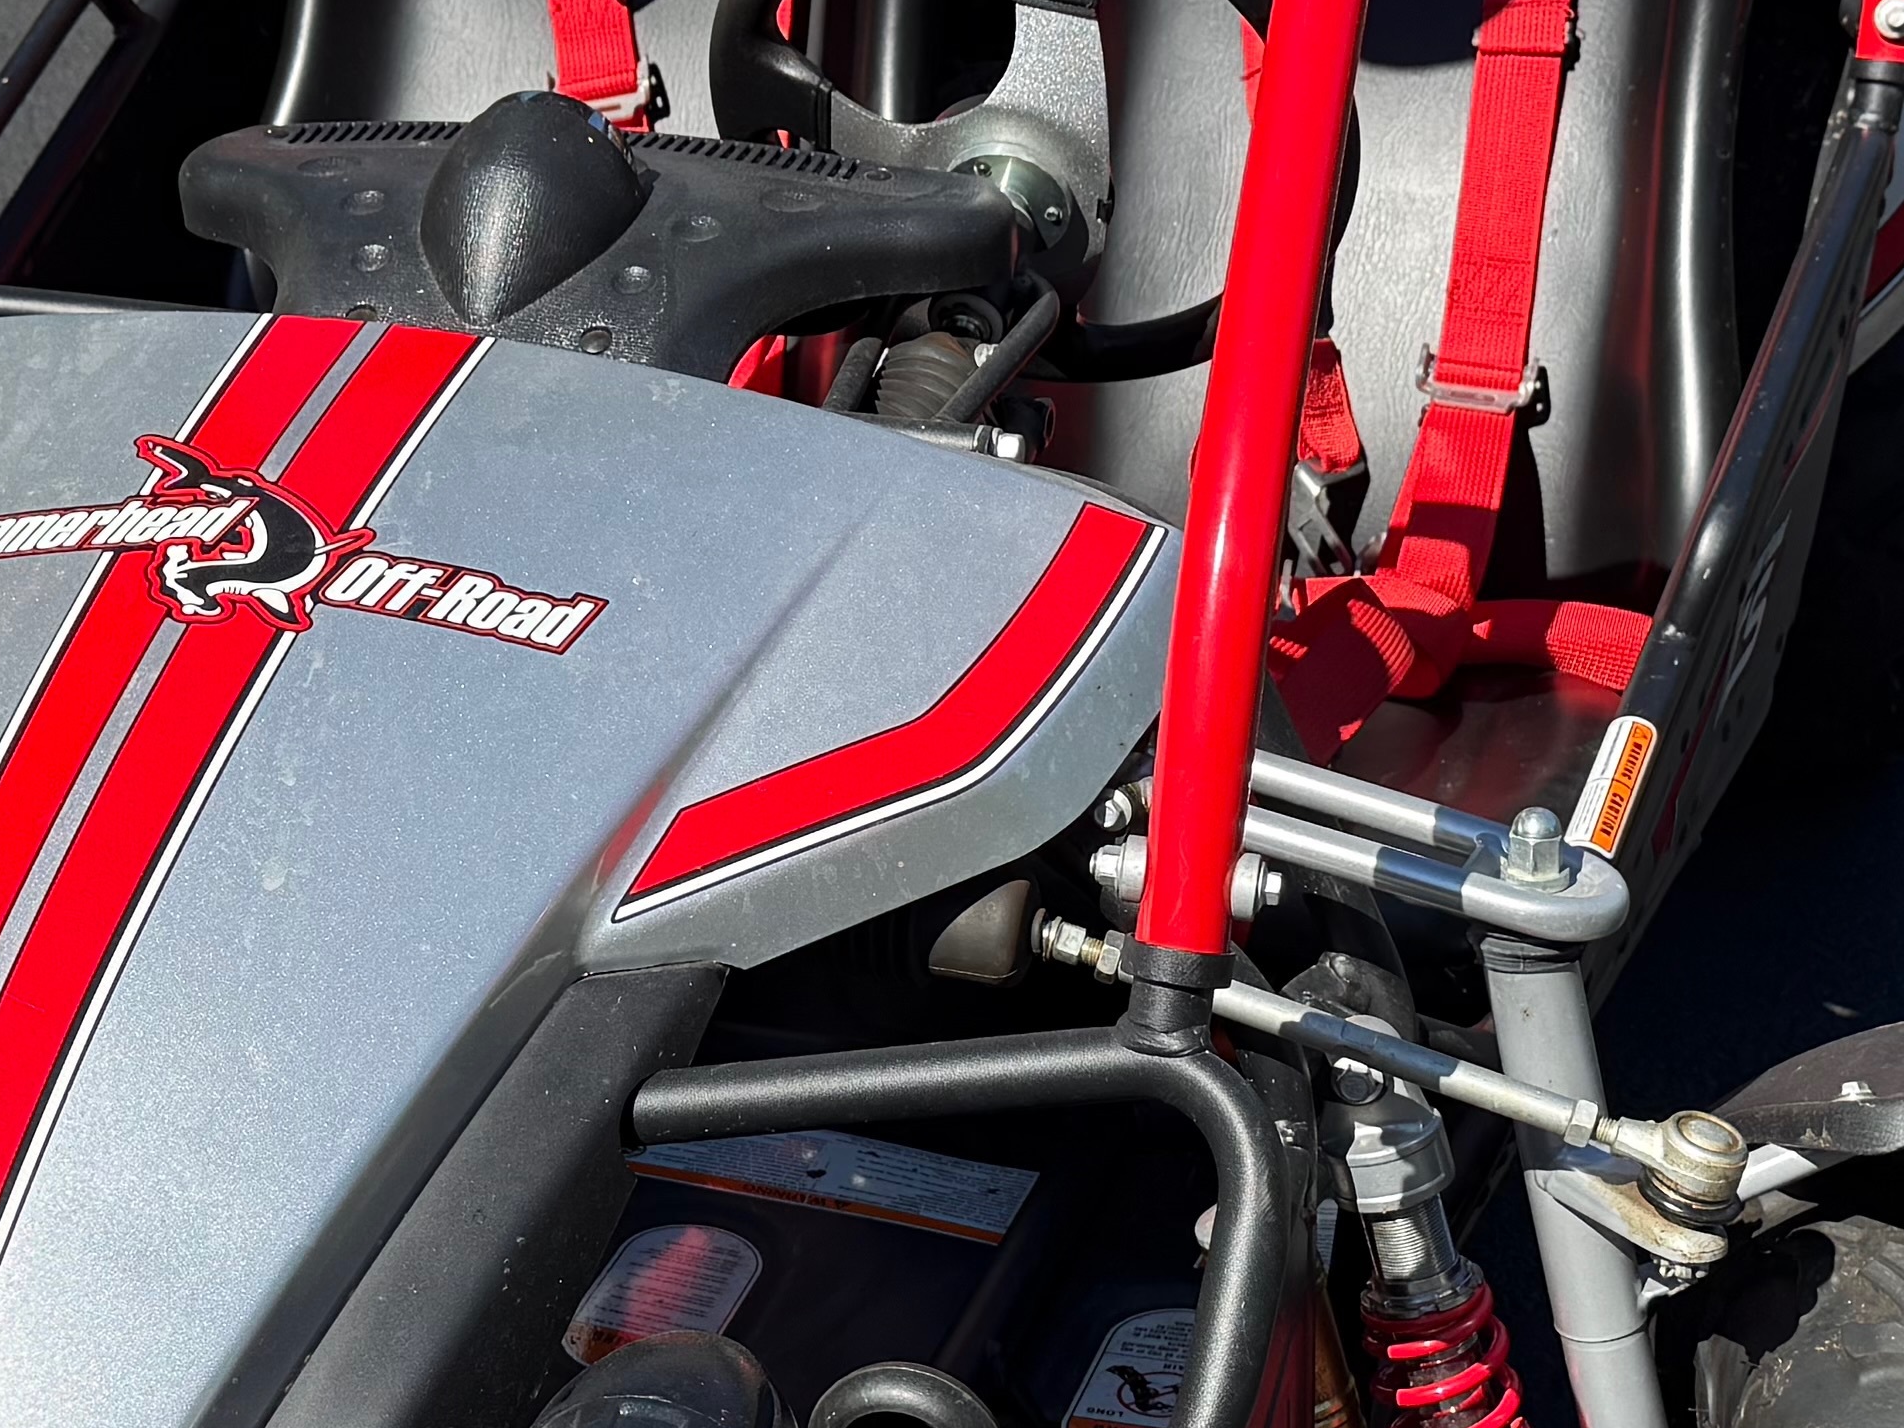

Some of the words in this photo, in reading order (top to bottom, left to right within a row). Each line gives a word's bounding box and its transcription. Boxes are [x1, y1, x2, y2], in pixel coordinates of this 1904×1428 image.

[325, 555, 601, 649] Off-Road
[1601, 793, 1624, 837] CAUTION
[1163, 1363, 1185, 1371] AIR
